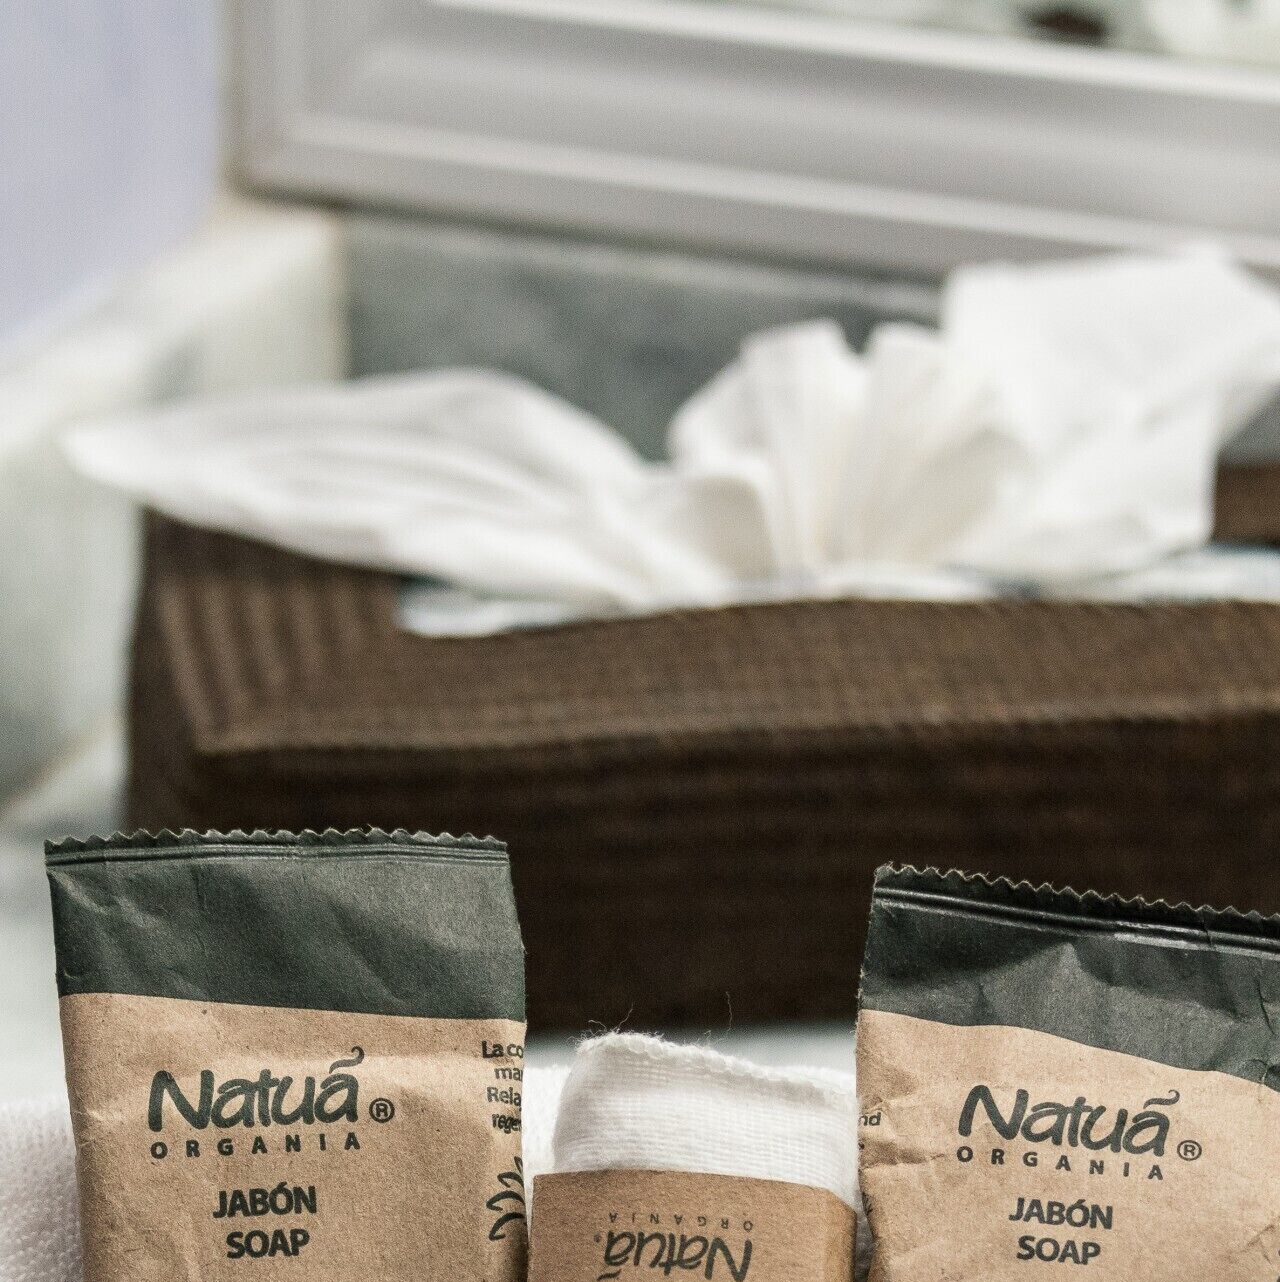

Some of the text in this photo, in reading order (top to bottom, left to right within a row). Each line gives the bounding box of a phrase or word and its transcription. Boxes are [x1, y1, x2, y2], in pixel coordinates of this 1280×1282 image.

[482, 1040, 504, 1059] La
[494, 1067, 523, 1082] ma
[487, 1086, 522, 1111] Rela
[491, 1113, 522, 1134] rege
[150, 1131, 361, 1160] ORGANIA
[957, 1145, 1163, 1181] ORGANIA
[213, 1182, 317, 1219] JABÓN
[1009, 1197, 1113, 1230] JABÓN
[609, 1212, 754, 1232] ORGANIA
[226, 1228, 310, 1260] SOAP
[1017, 1236, 1101, 1266] SOAP
